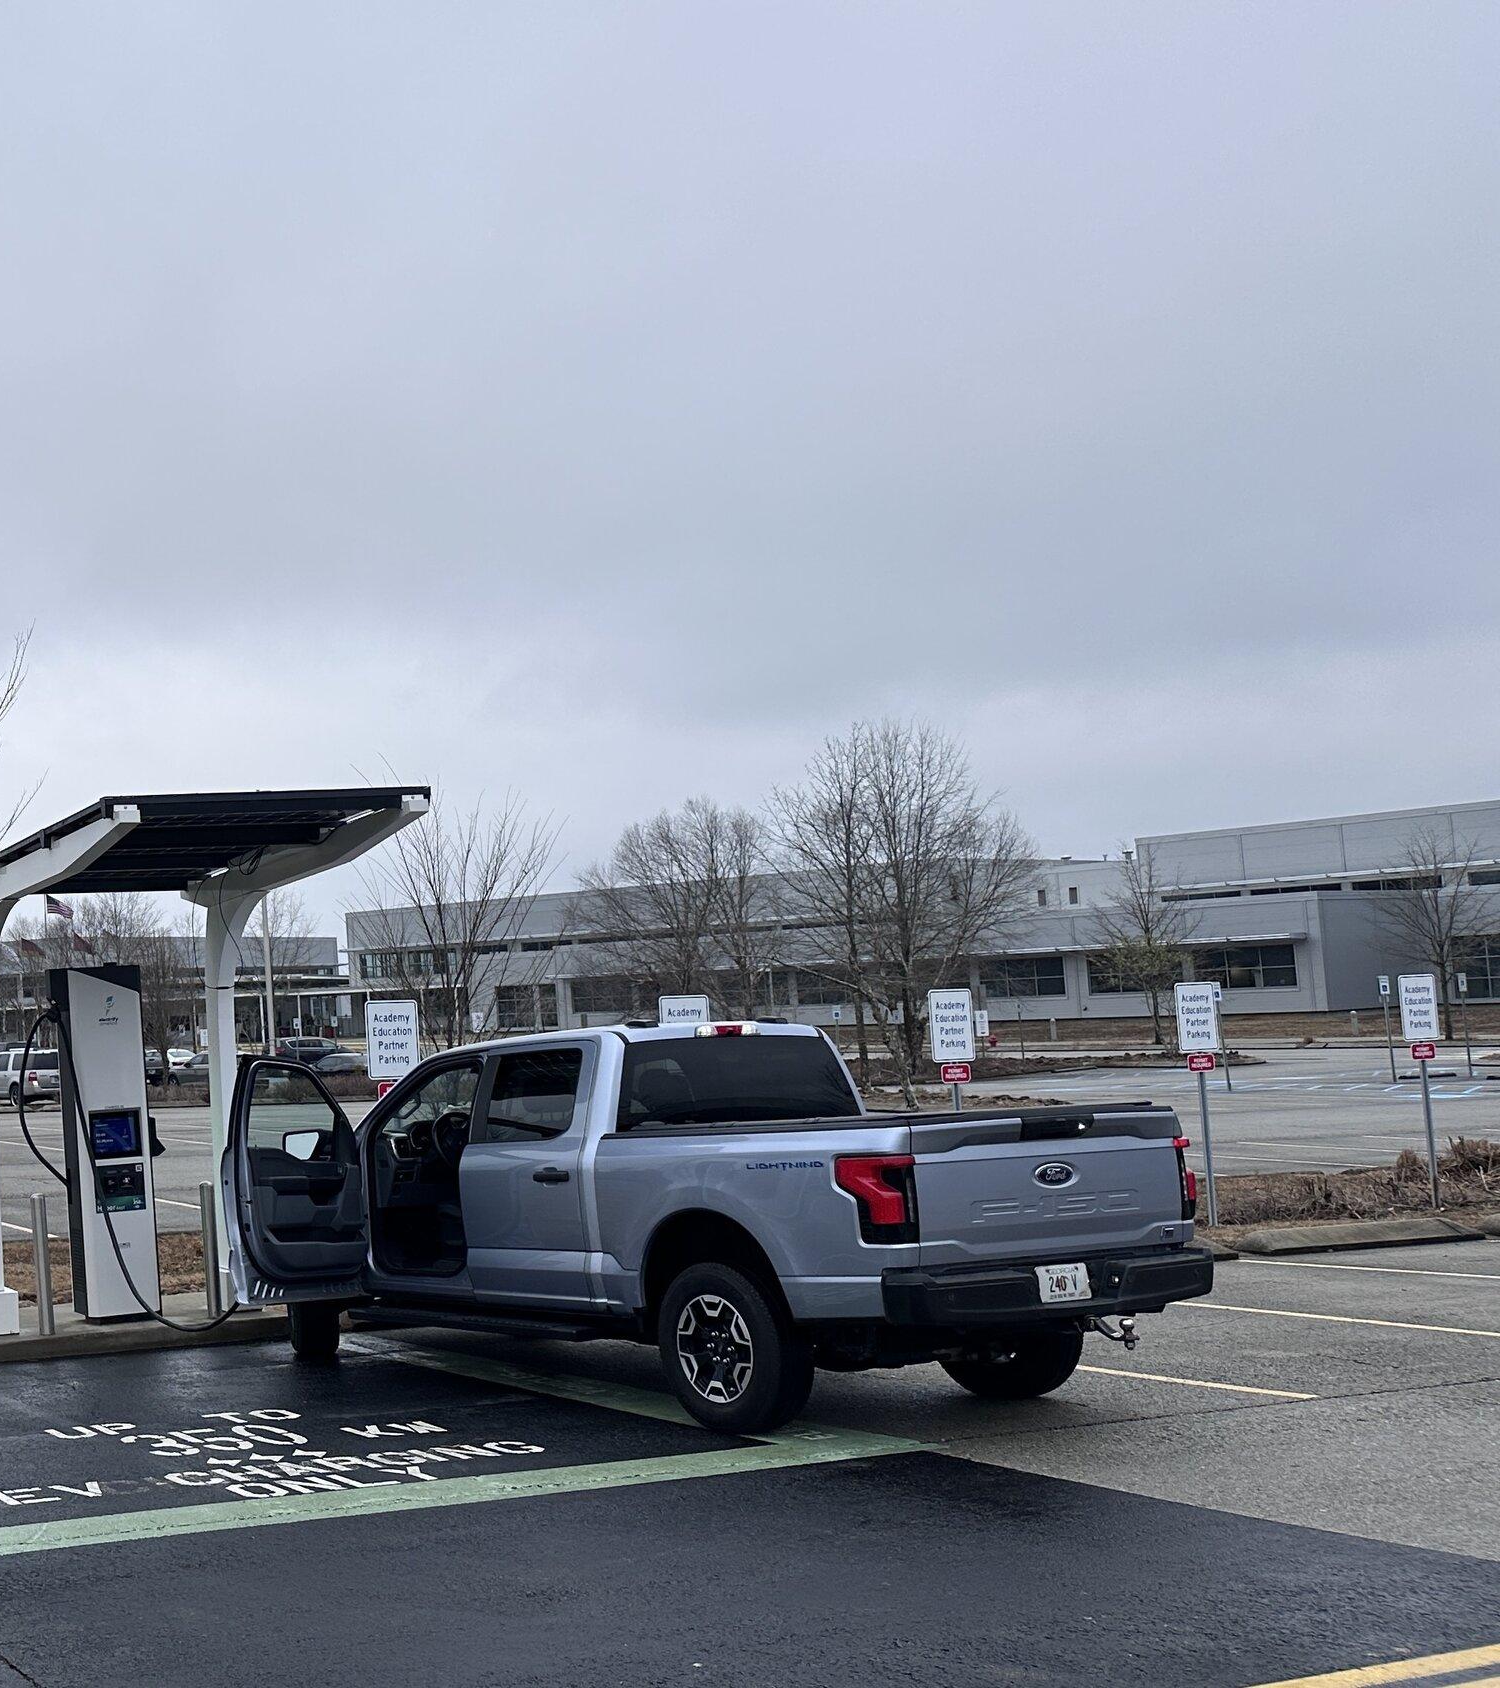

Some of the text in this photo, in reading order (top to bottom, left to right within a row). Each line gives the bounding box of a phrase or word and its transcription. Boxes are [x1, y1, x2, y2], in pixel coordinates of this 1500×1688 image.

[1404, 985, 1430, 995] Academy
[1181, 994, 1209, 1003] Academy
[1404, 997, 1432, 1005] Education
[936, 1001, 965, 1011] Academy
[1181, 1006, 1211, 1014] Education
[667, 1008, 701, 1018] Academy
[935, 1014, 967, 1022] Education
[373, 1013, 409, 1024] Academy
[1185, 1018, 1209, 1026] Partner
[1409, 1020, 1431, 1029] Parking
[372, 1027, 412, 1036] Education
[940, 1027, 964, 1035] Partner
[1186, 1030, 1211, 1039] Parking
[378, 1041, 408, 1050] Partner
[940, 1039, 966, 1049] Parking
[379, 1055, 409, 1065] Parking
[746, 1161, 824, 1171] LIGHTNING
[1046, 1167, 1067, 1181] Ford
[970, 1188, 1141, 1223] F-150
[1049, 1274, 1077, 1292] 240 V
[44, 1409, 301, 1439] UP TO
[120, 1420, 448, 1457] 350 KW
[164, 1441, 545, 1487] CHARGING
[225, 1466, 438, 1498] ONLY
